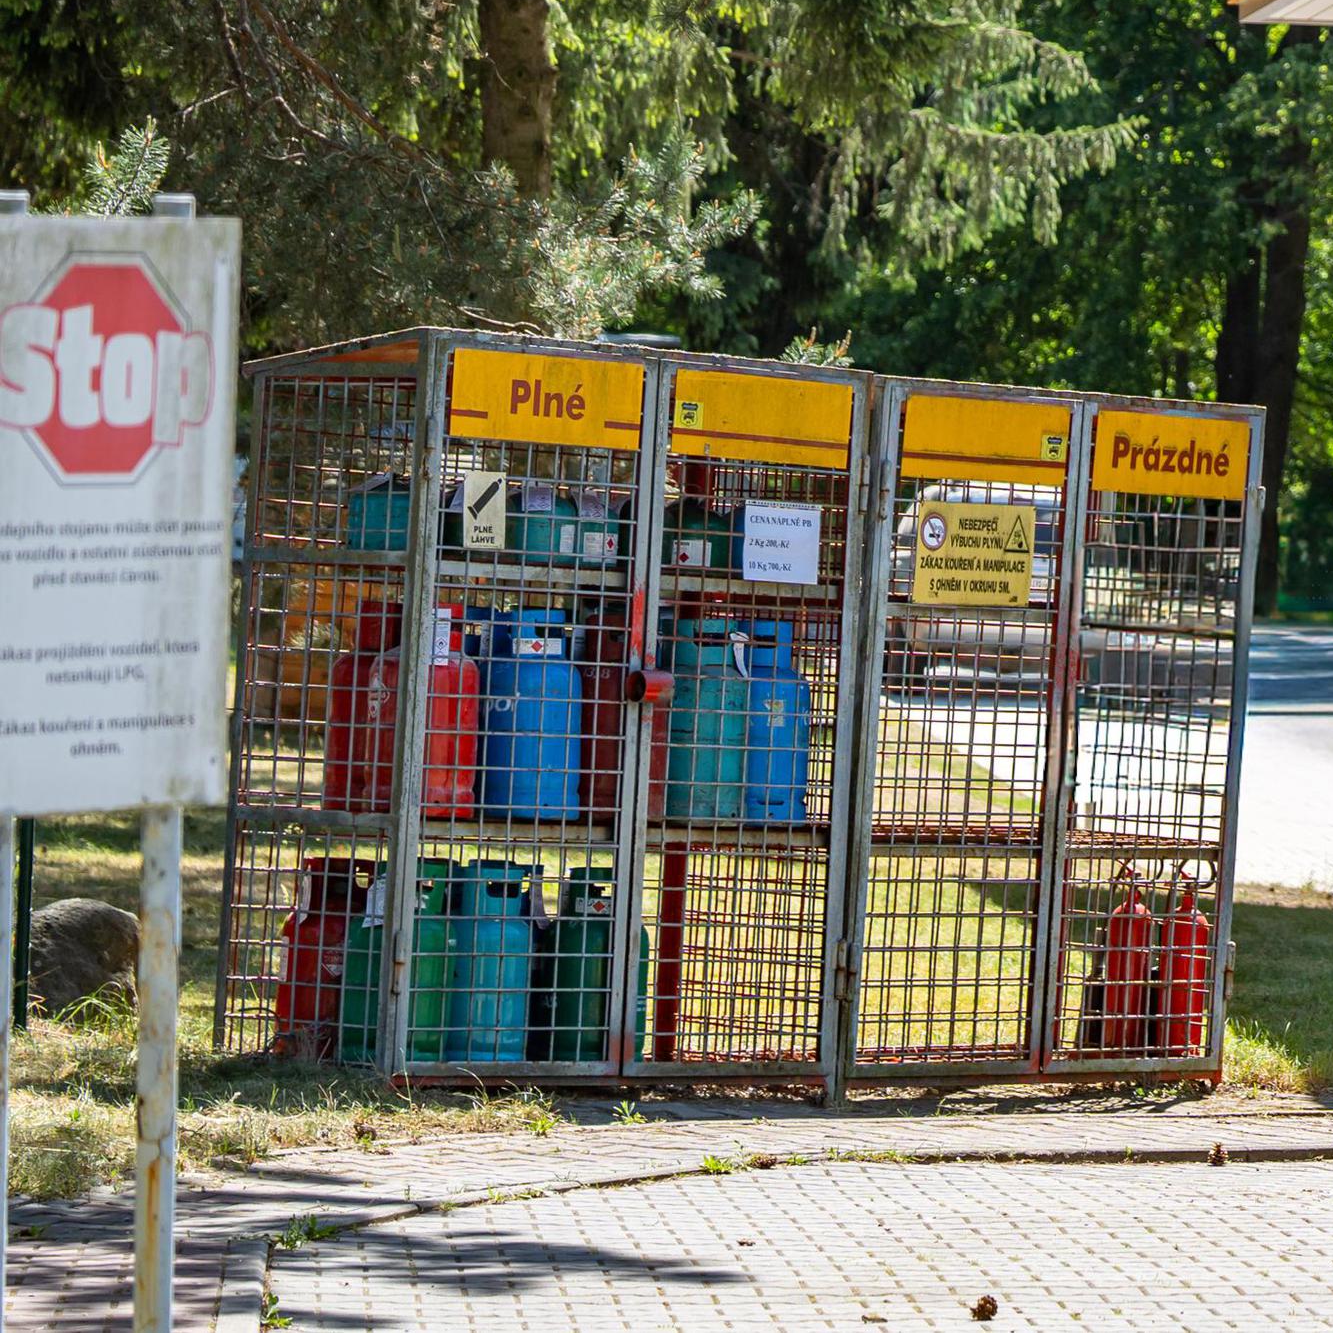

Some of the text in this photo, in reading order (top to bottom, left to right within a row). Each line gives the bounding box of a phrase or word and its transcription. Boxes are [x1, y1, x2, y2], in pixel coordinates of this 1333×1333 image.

[0, 300, 214, 447] Stop
[510, 378, 586, 420] Plné
[1112, 435, 1230, 476] Prázdné
[750, 515, 770, 524] CENA
[963, 580, 969, 592] V
